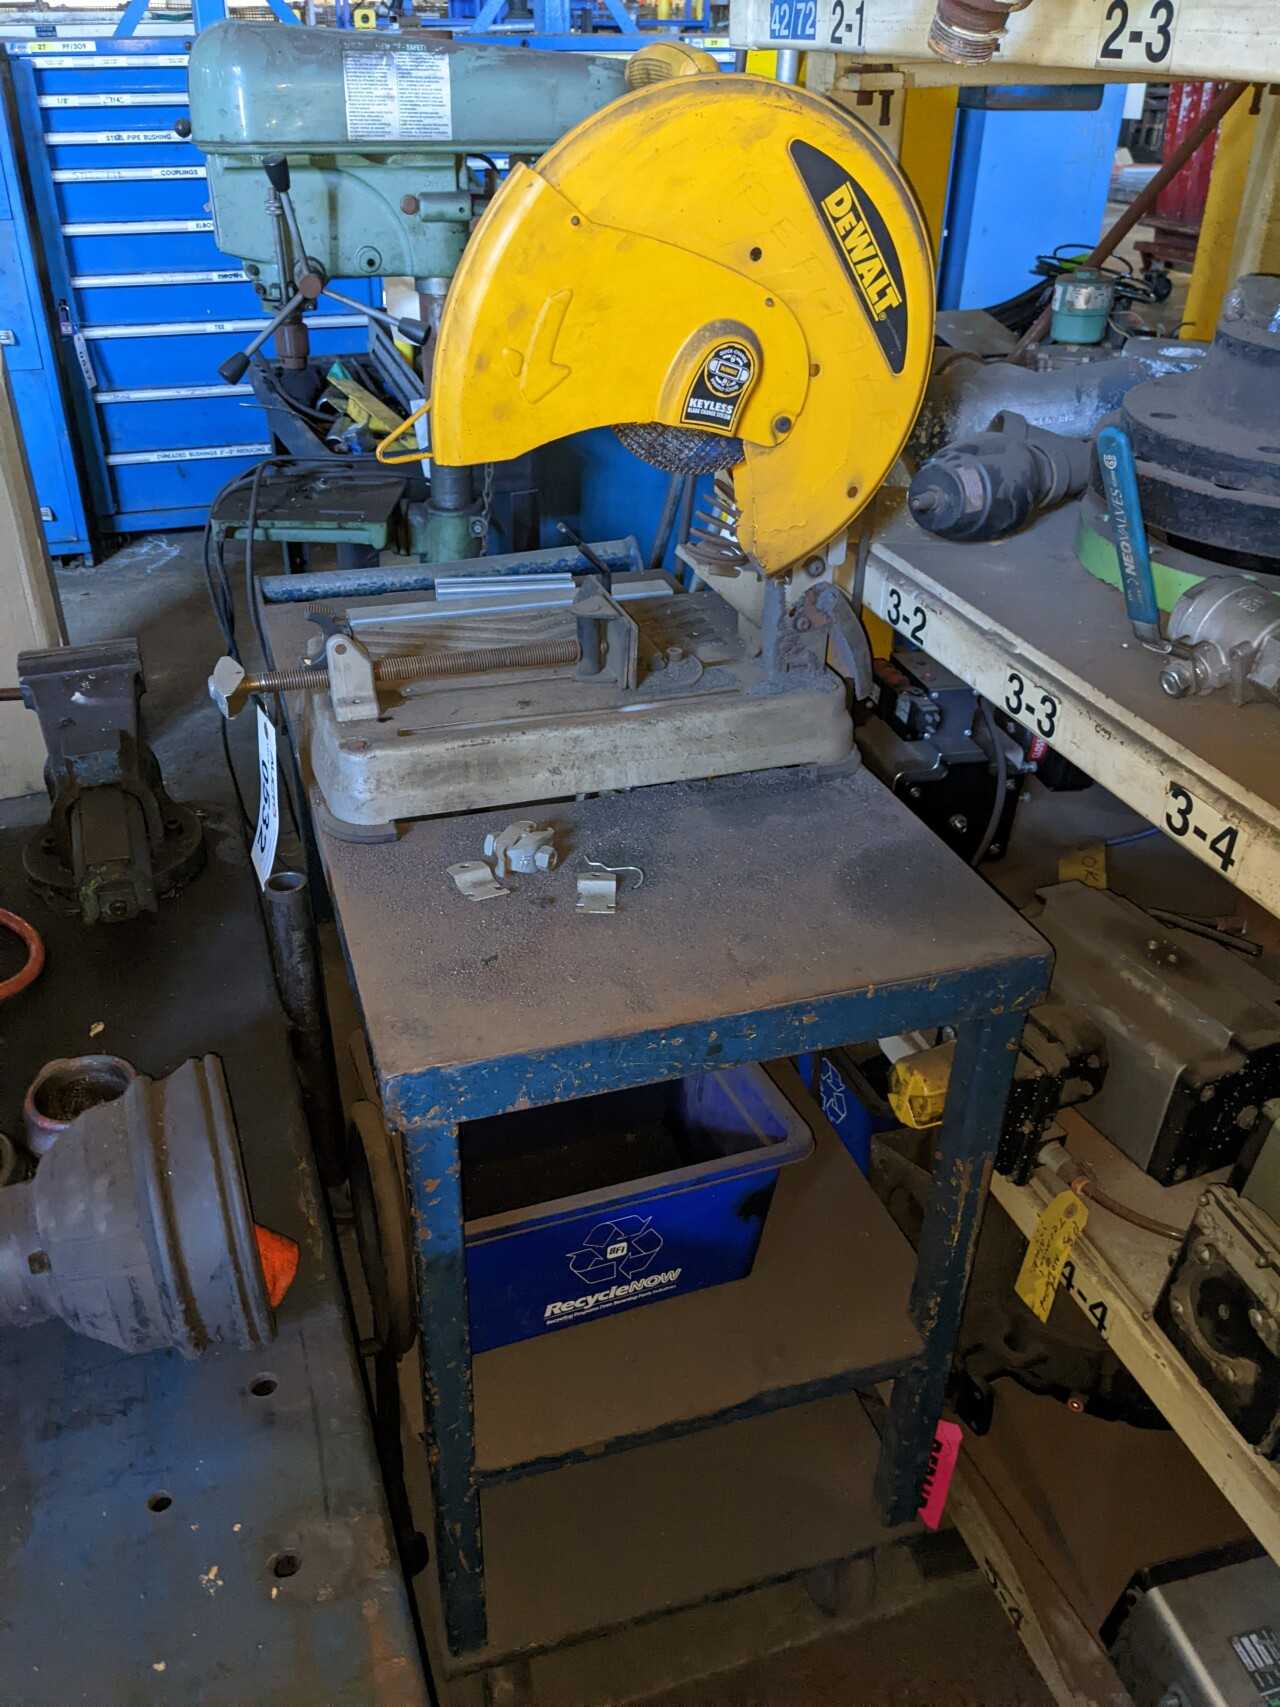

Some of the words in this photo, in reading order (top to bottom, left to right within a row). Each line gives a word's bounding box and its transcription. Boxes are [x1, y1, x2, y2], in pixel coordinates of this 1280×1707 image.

[830, 0, 864, 46] 2-1
[1099, 0, 1174, 63] 2-3
[160, 168, 199, 177] COUPLINGS
[824, 182, 900, 314] DEWALT
[689, 398, 734, 415] KEYLESS
[1110, 486, 1137, 577] NEOVALVES
[887, 587, 928, 647] 3-2
[1005, 672, 1058, 739] 3-3
[1165, 785, 1240, 873] 3-4
[543, 1267, 682, 1317] RecycleNOW
